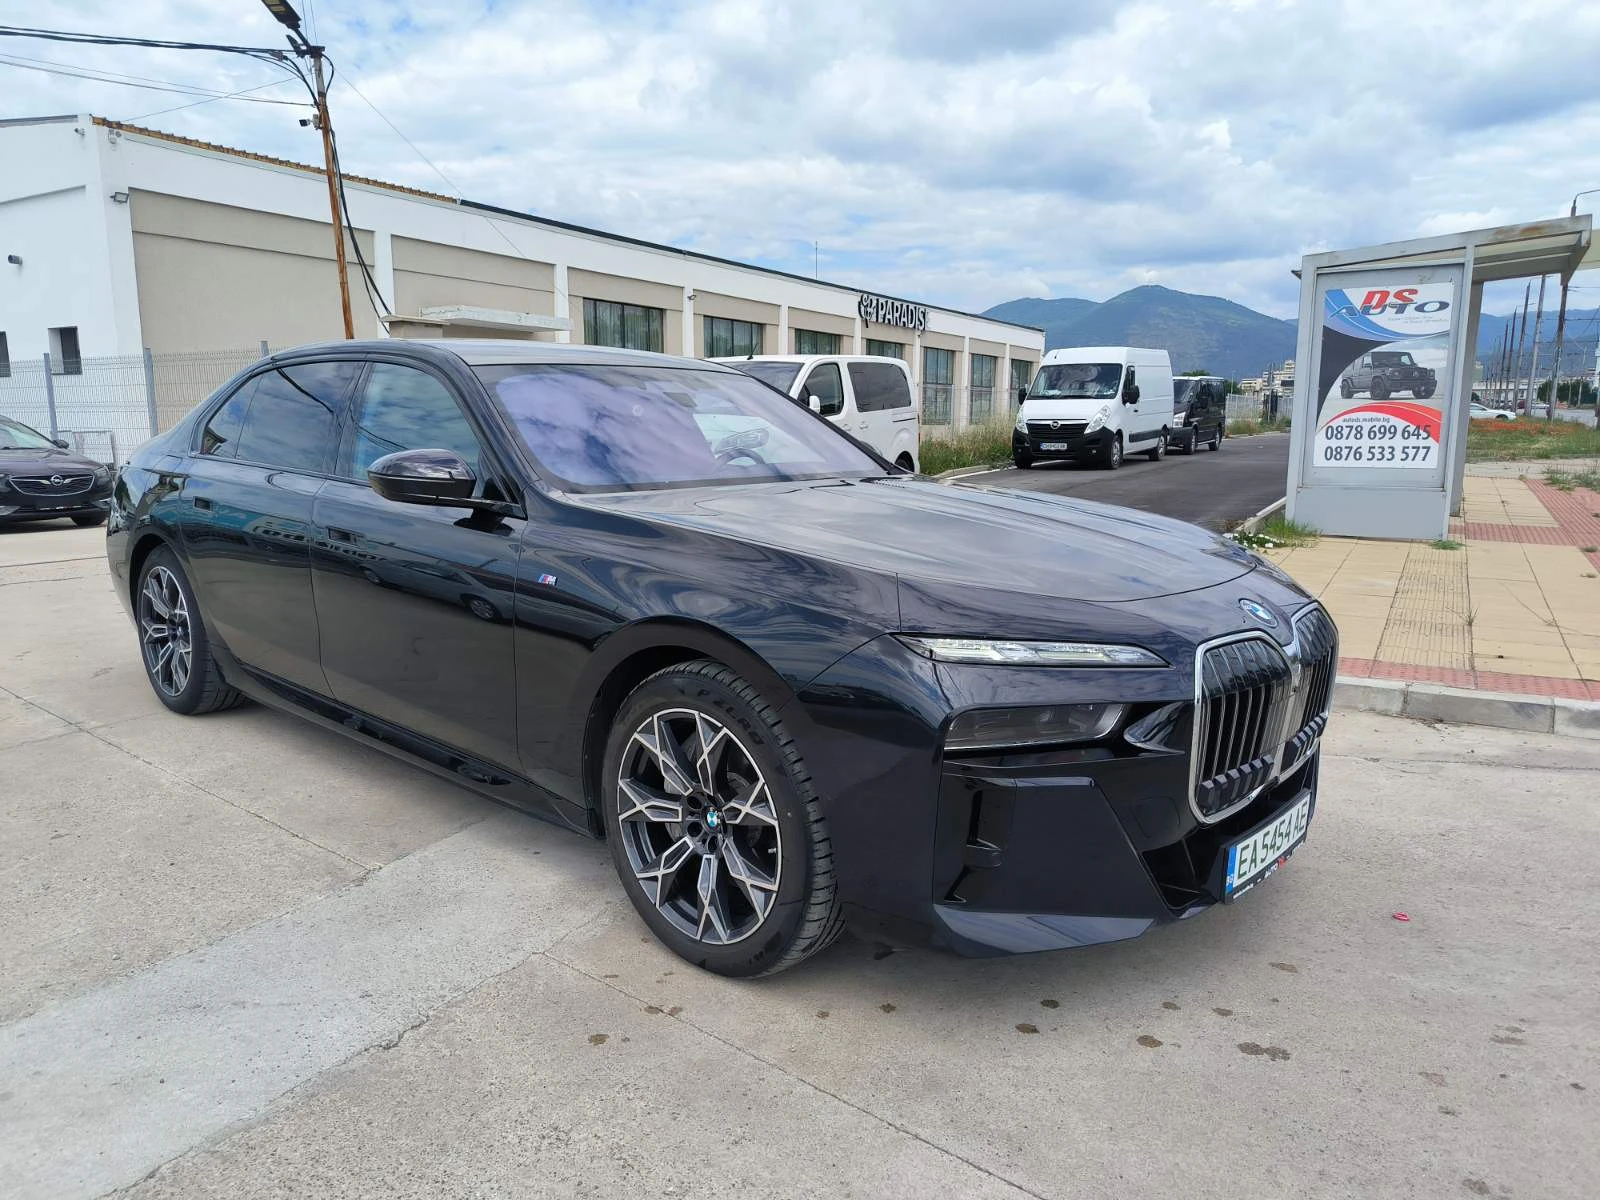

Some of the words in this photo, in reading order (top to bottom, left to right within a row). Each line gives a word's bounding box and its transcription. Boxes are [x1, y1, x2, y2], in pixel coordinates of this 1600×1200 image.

[1360, 288, 1419, 310] DS
[879, 300, 926, 330] PARADIS
[1328, 301, 1450, 320] AUTO
[1325, 425, 1364, 440] 0878
[1367, 425, 1398, 440] 699
[1401, 424, 1432, 440] 645
[1324, 446, 1363, 461] 0876
[1366, 446, 1396, 461] 533
[1400, 446, 1431, 461] 577
[1238, 839, 1258, 879] EA
[1260, 813, 1293, 863] 5454
[1293, 802, 1308, 838] AE
